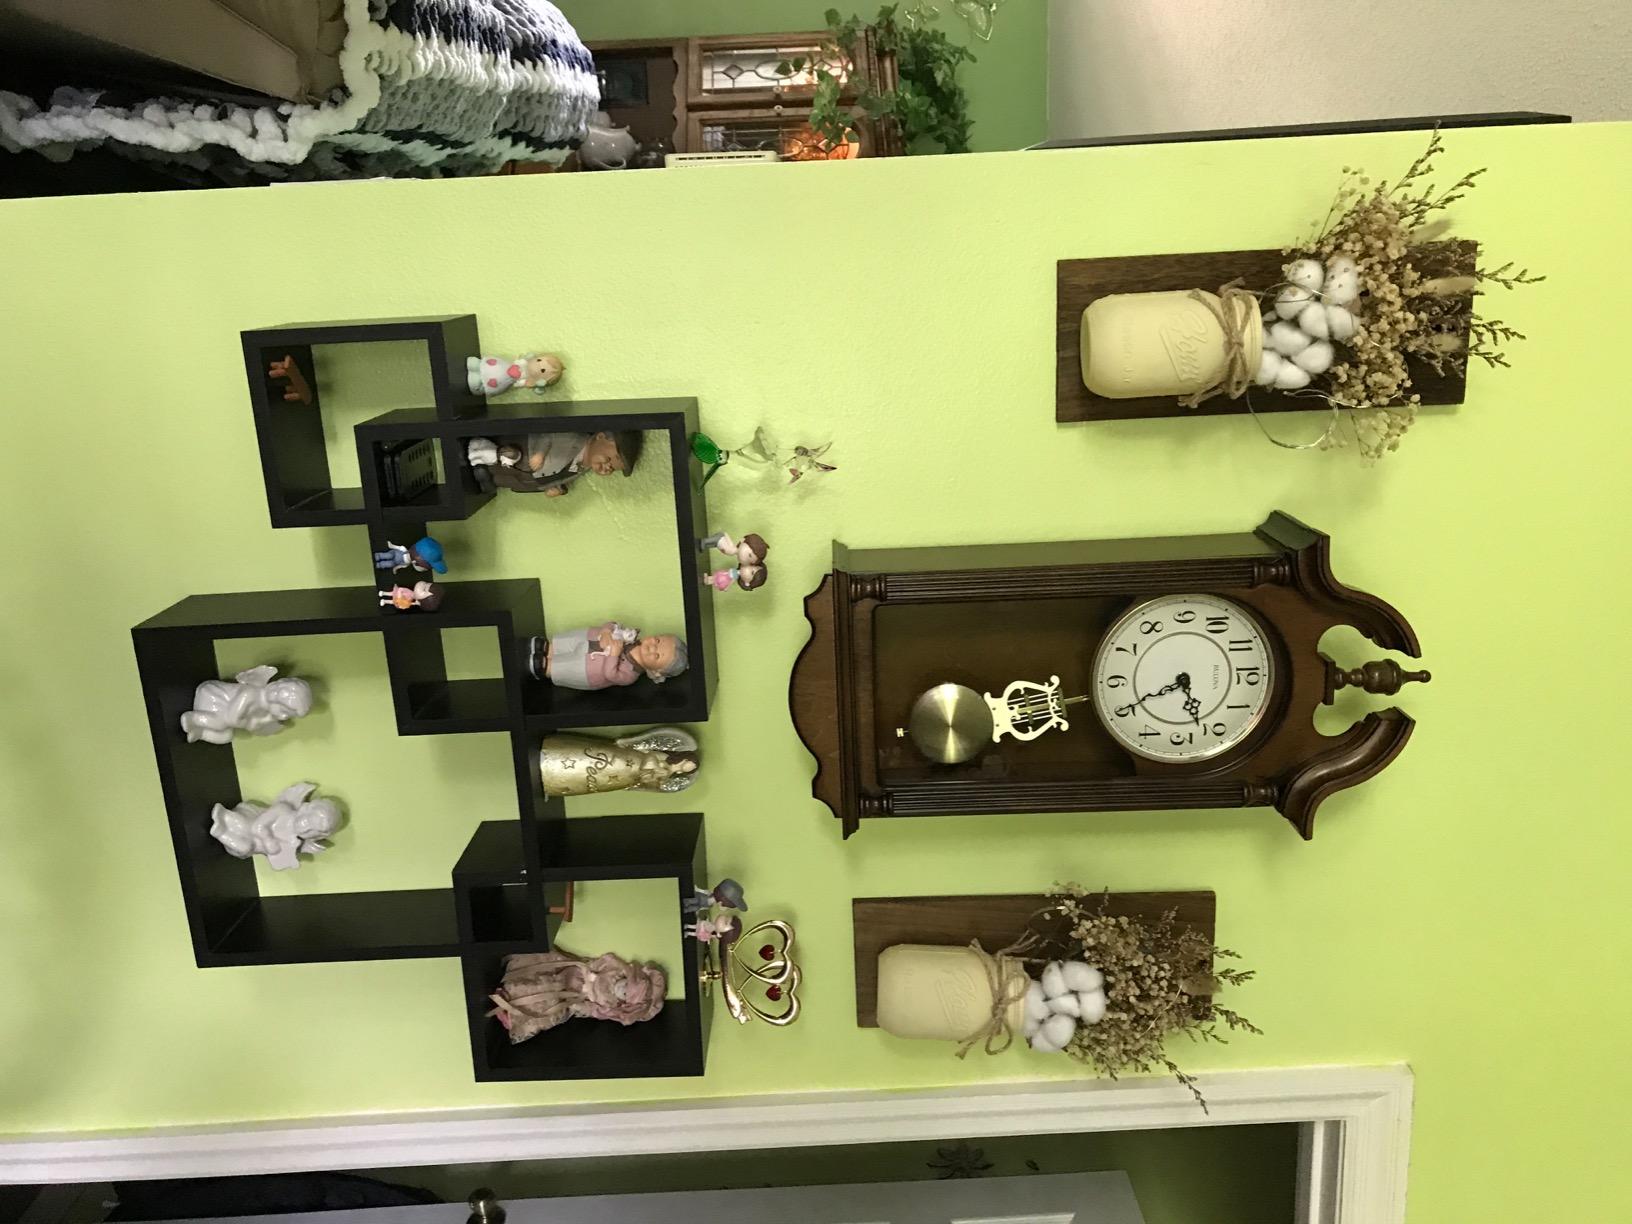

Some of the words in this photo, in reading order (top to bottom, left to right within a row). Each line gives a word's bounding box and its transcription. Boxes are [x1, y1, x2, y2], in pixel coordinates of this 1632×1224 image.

[1173, 610, 1197, 624] 9
[1205, 615, 1230, 634] 10
[1139, 620, 1164, 635] 8
[1115, 643, 1137, 656] 7
[1228, 639, 1253, 652] 11
[1106, 674, 1128, 689] 6
[1212, 664, 1220, 690] BULOVA
[1235, 666, 1260, 686] 12
[1114, 703, 1136, 718] 5
[1138, 724, 1161, 739] 4
[1202, 722, 1227, 737] 2
[1169, 732, 1193, 746] 3
